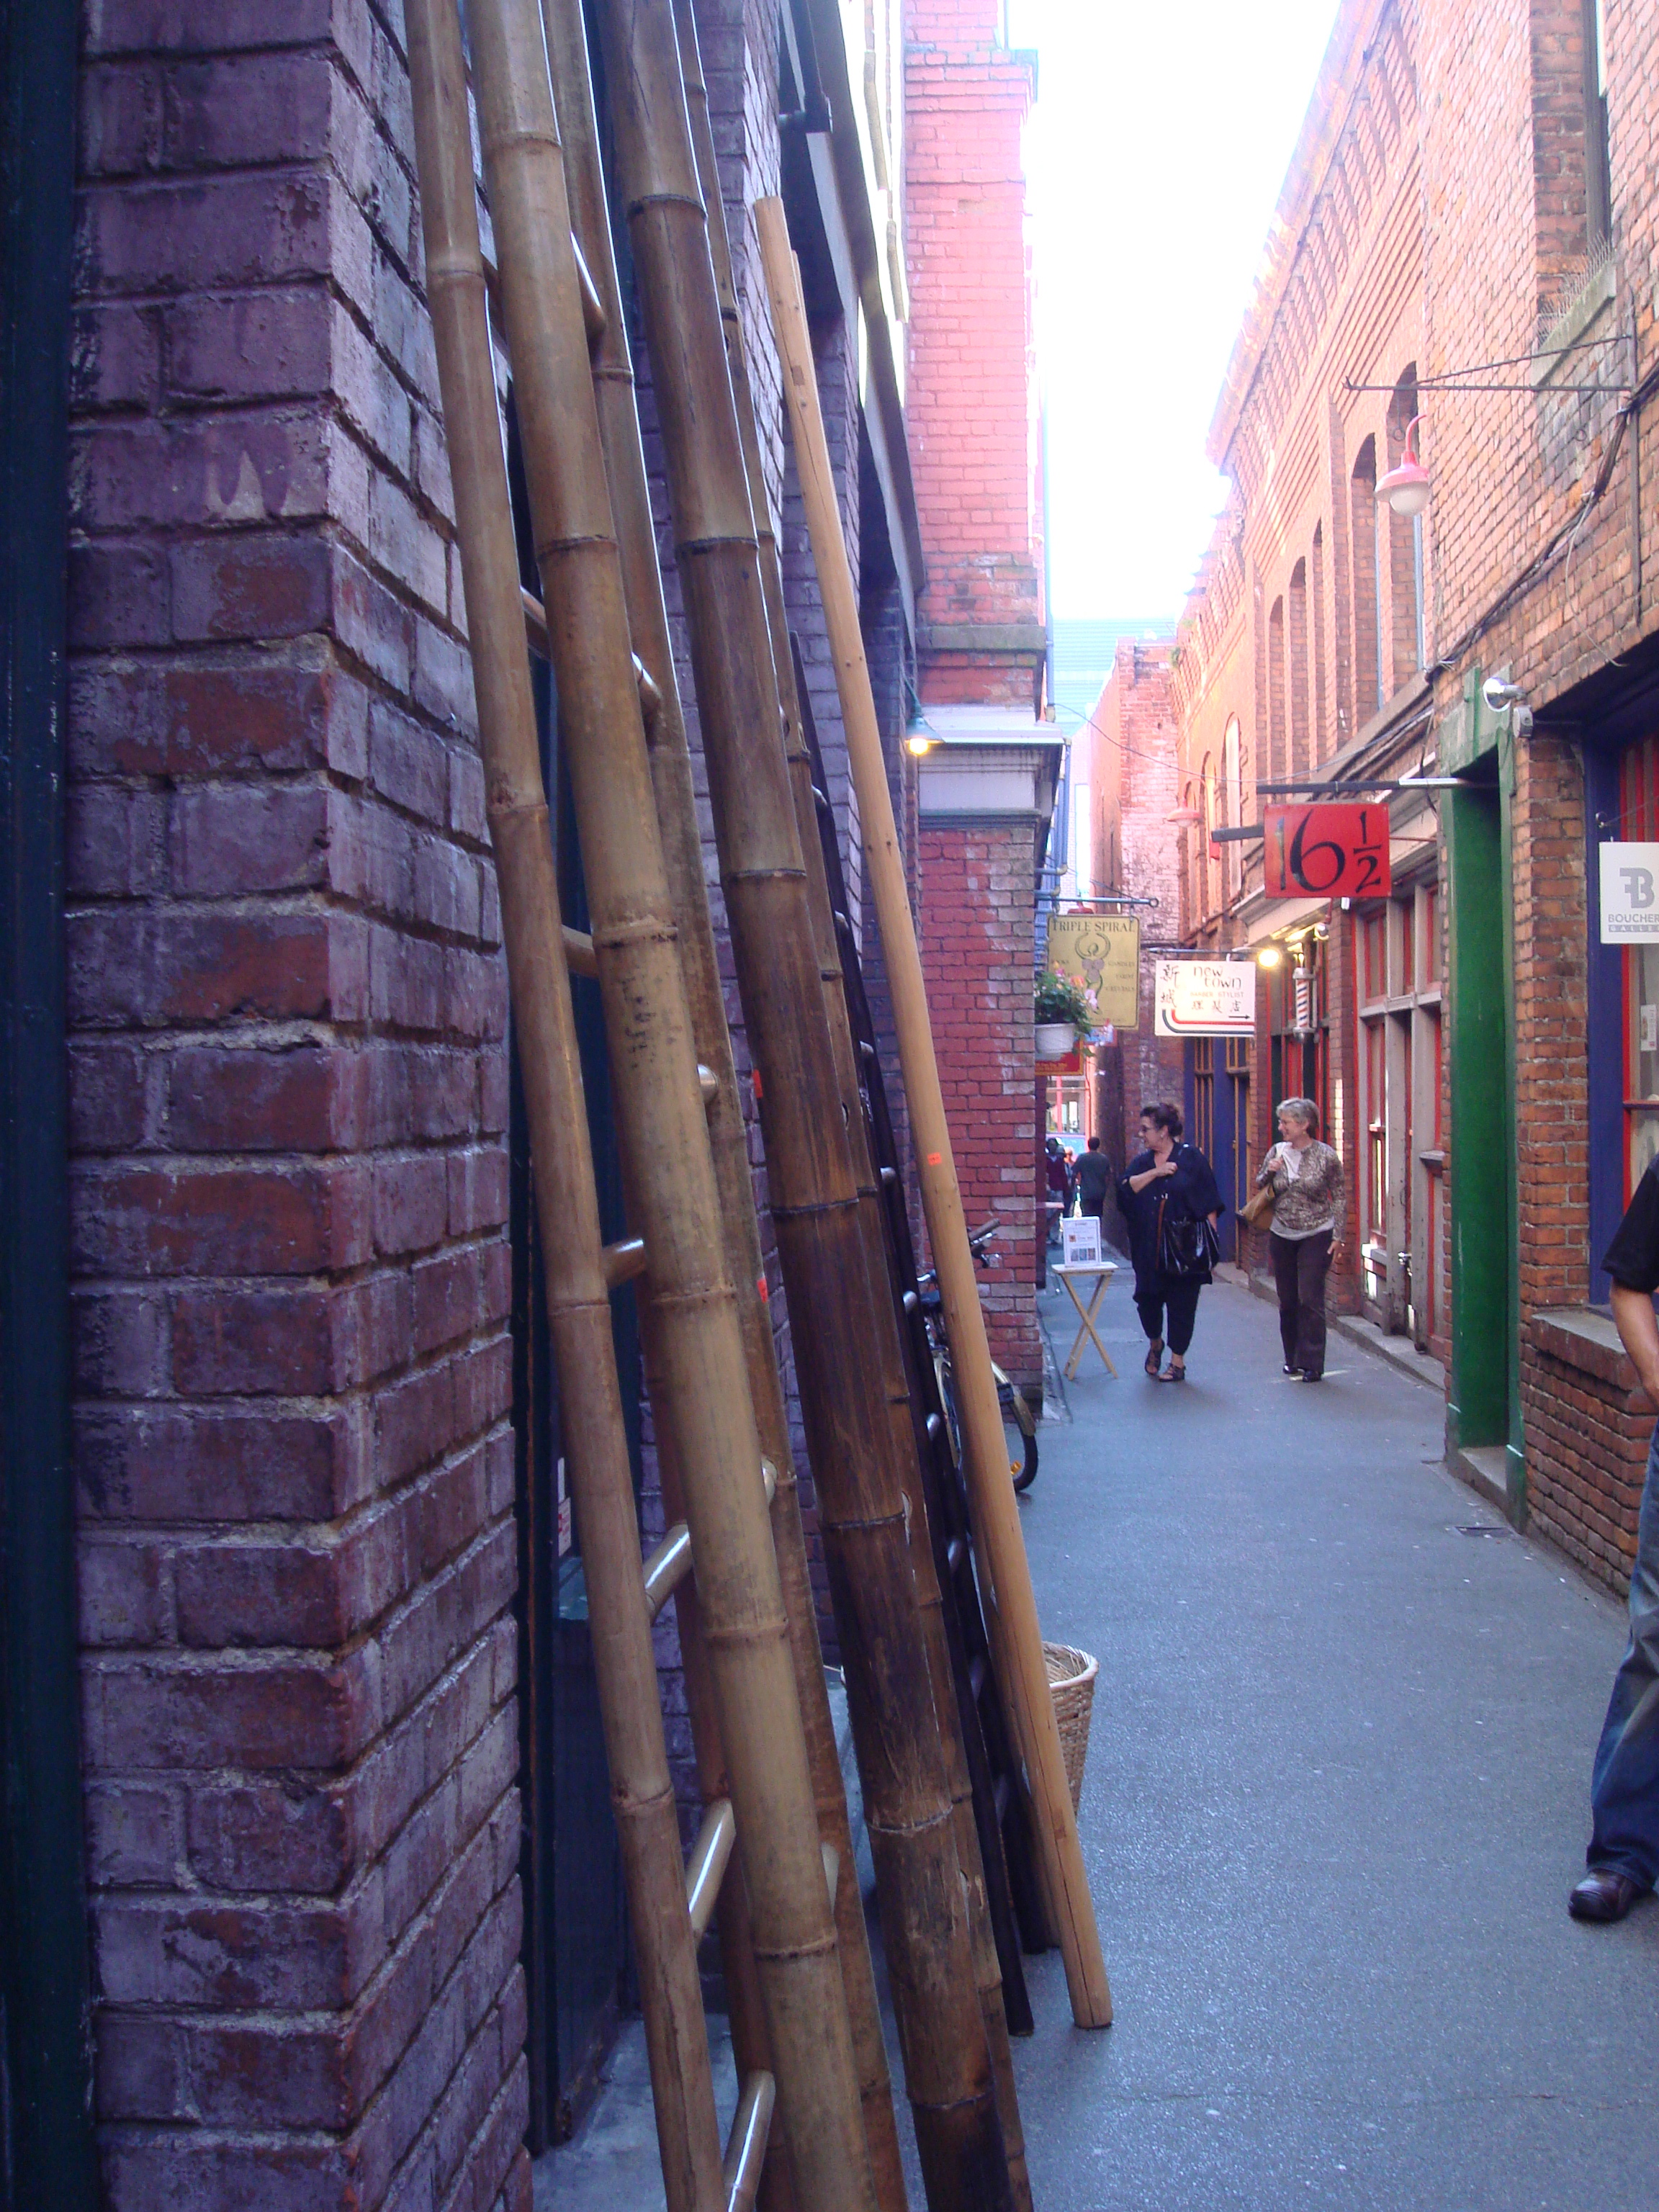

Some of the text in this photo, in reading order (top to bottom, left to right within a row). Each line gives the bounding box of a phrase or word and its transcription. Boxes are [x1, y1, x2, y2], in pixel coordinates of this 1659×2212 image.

[1274, 809, 1345, 892] 16
[1053, 921, 1136, 932] TRIPLE SPIRAL
